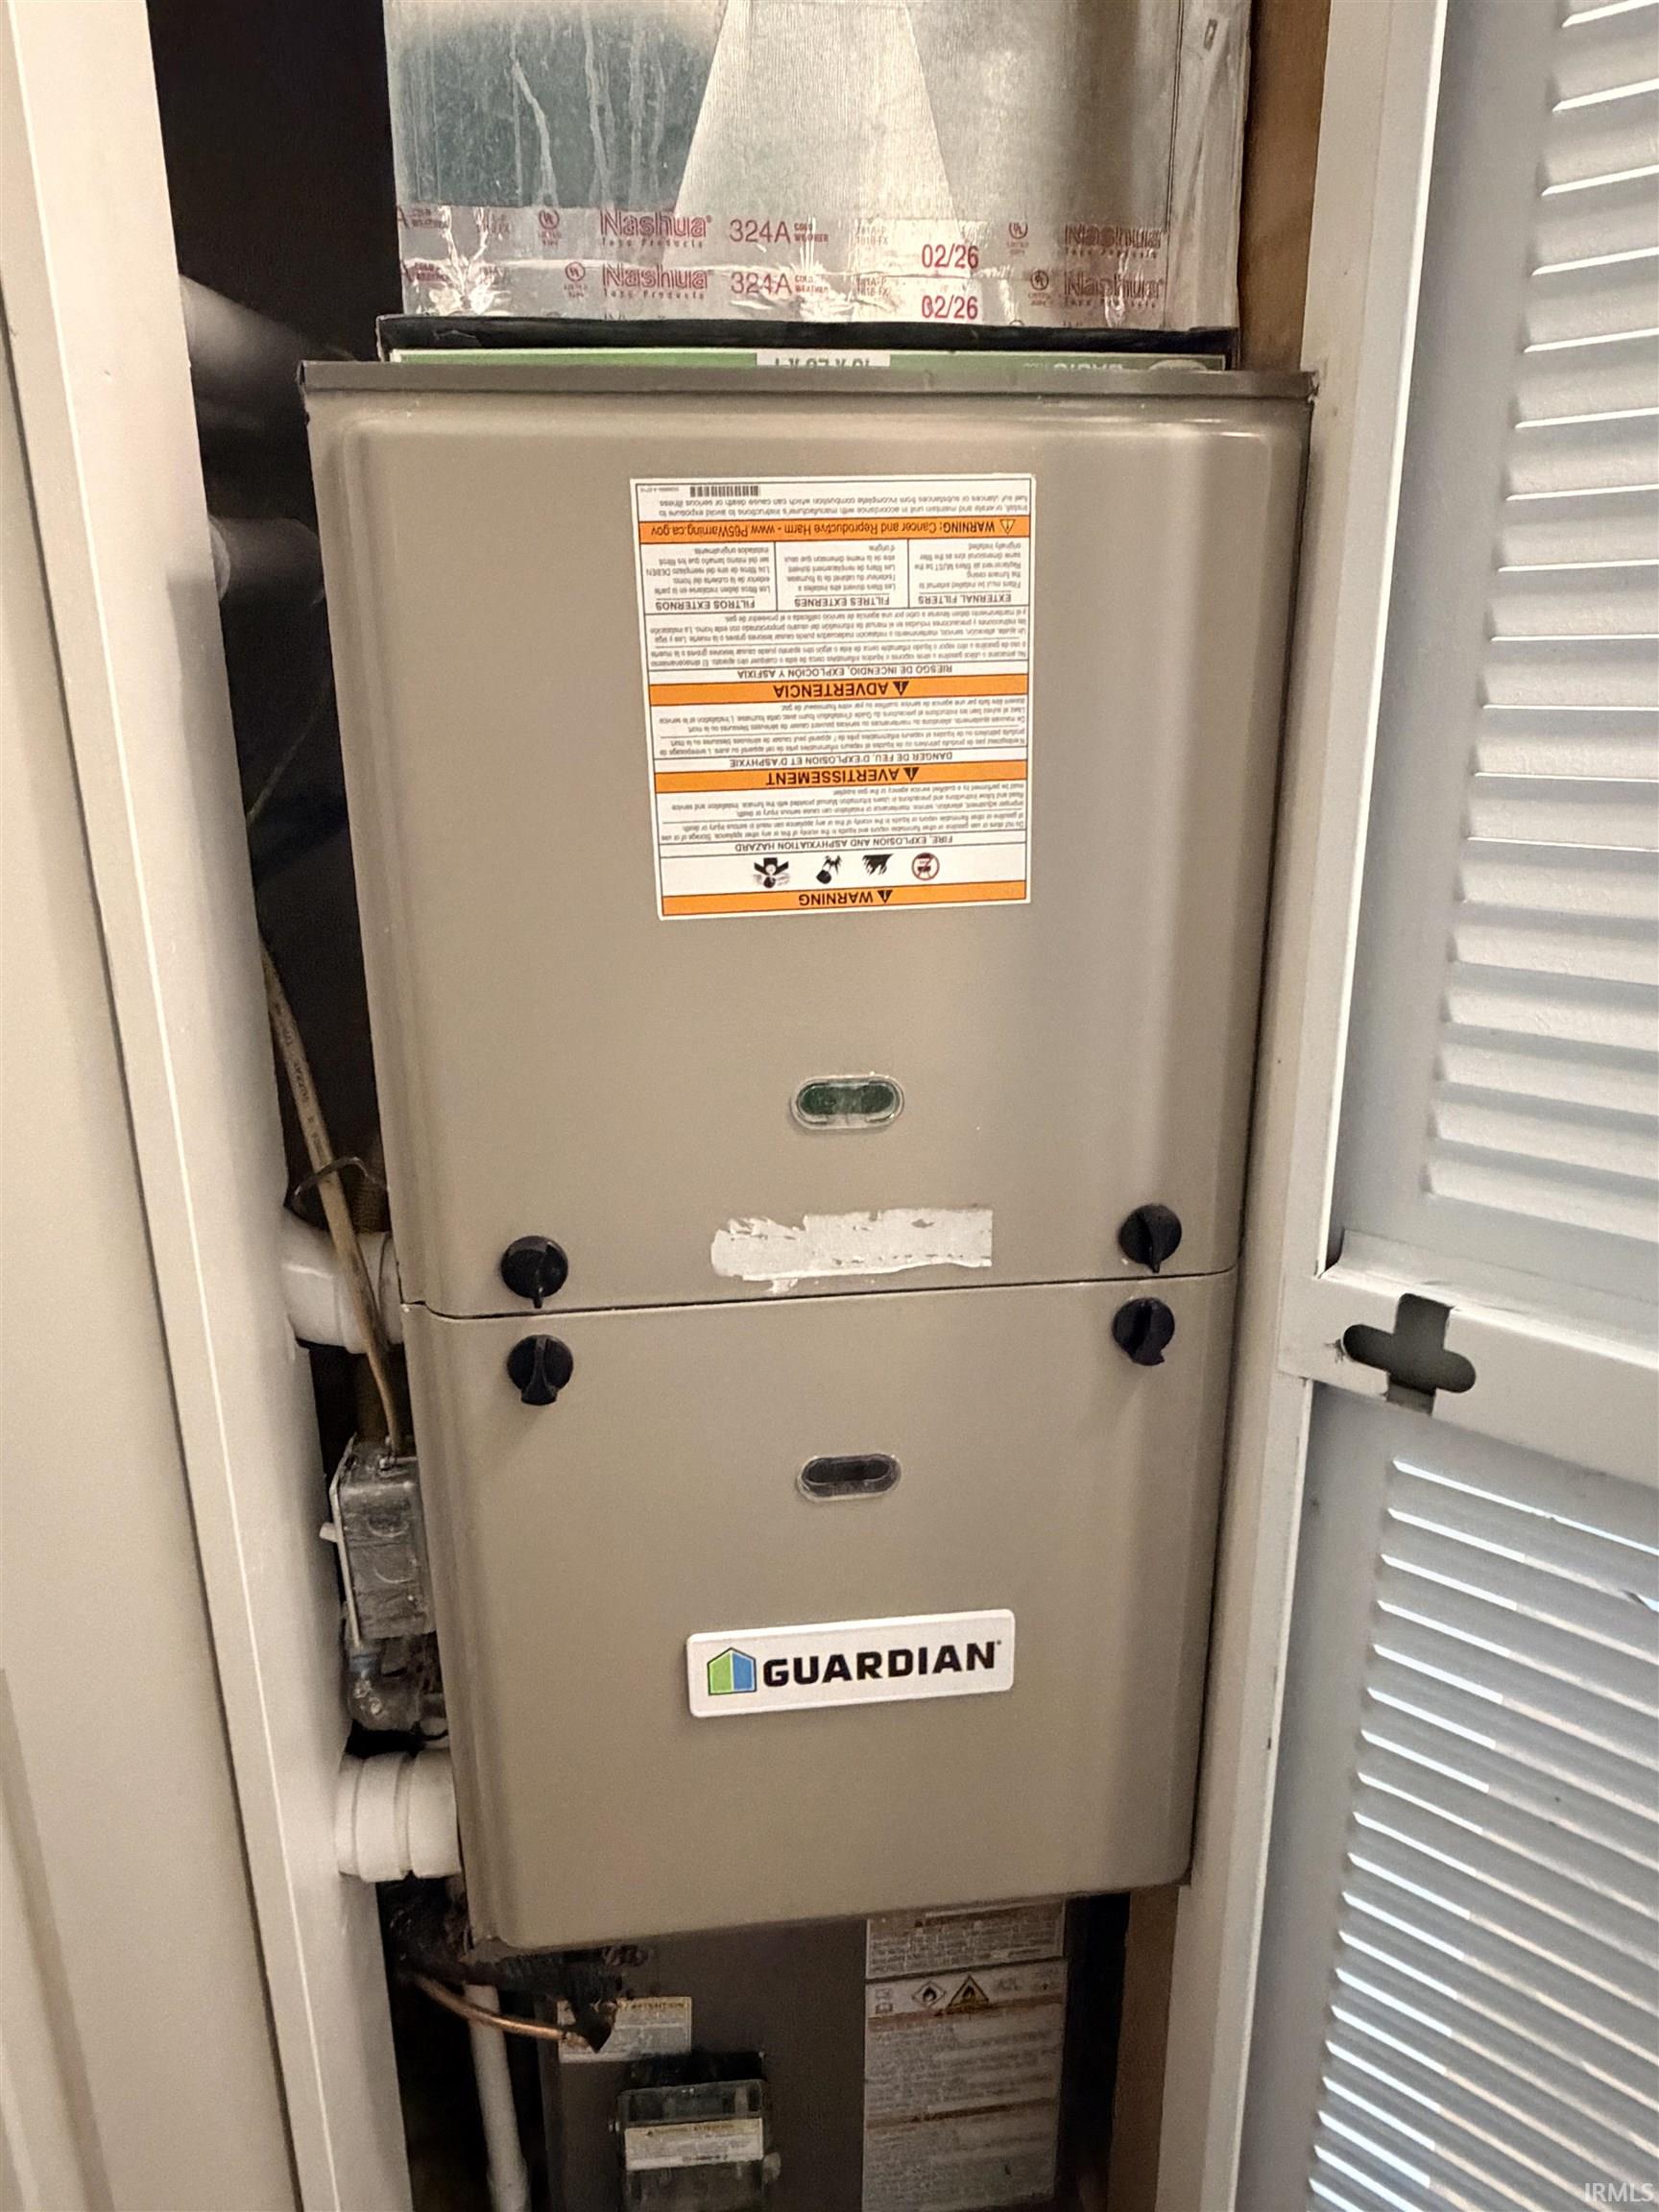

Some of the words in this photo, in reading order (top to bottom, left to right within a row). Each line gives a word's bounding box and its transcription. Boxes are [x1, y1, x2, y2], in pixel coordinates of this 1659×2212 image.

[600, 209, 706, 238] Nashua
[730, 219, 792, 245] 324A
[922, 243, 979, 270] 02/26
[603, 263, 708, 290] Nashua
[731, 271, 792, 296] 324A
[922, 295, 978, 321] 02/26
[784, 524, 812, 536] Harm
[814, 523, 878, 536] Reproductive
[881, 522, 900, 534] and
[902, 522, 937, 535] Cancer
[940, 521, 996, 534] WARNING:
[795, 598, 848, 608] EXTERNES
[851, 597, 890, 607] FILTRES
[919, 595, 957, 605] FILTERS
[961, 594, 1012, 604] EXTERNAL
[656, 601, 711, 611] EXTERNOS
[713, 600, 756, 610] FILTROS
[737, 668, 777, 680] ASFIXIA
[779, 668, 785, 679] Y
[848, 665, 898, 676] INCENDIO,
[901, 664, 913, 675] DE
[916, 663, 952, 674] RIESGO
[774, 683, 889, 699] ADVERTENCIA
[791, 757, 803, 766] ET
[805, 755, 871, 765] D'EXPLOSION
[898, 754, 910, 762] DE
[913, 752, 953, 761] DANGER
[730, 757, 788, 768] D'ASPHYXIE
[766, 768, 900, 785] AVERTISSEMENT
[851, 839, 871, 848] AND
[873, 836, 927, 847] EXPLOSION
[928, 834, 953, 844] FIRE,
[735, 843, 776, 853] HAZARD
[778, 840, 848, 851] ASPHYXIATION
[799, 891, 874, 906] WARNING
[763, 1641, 996, 1688] GUARDIAN
